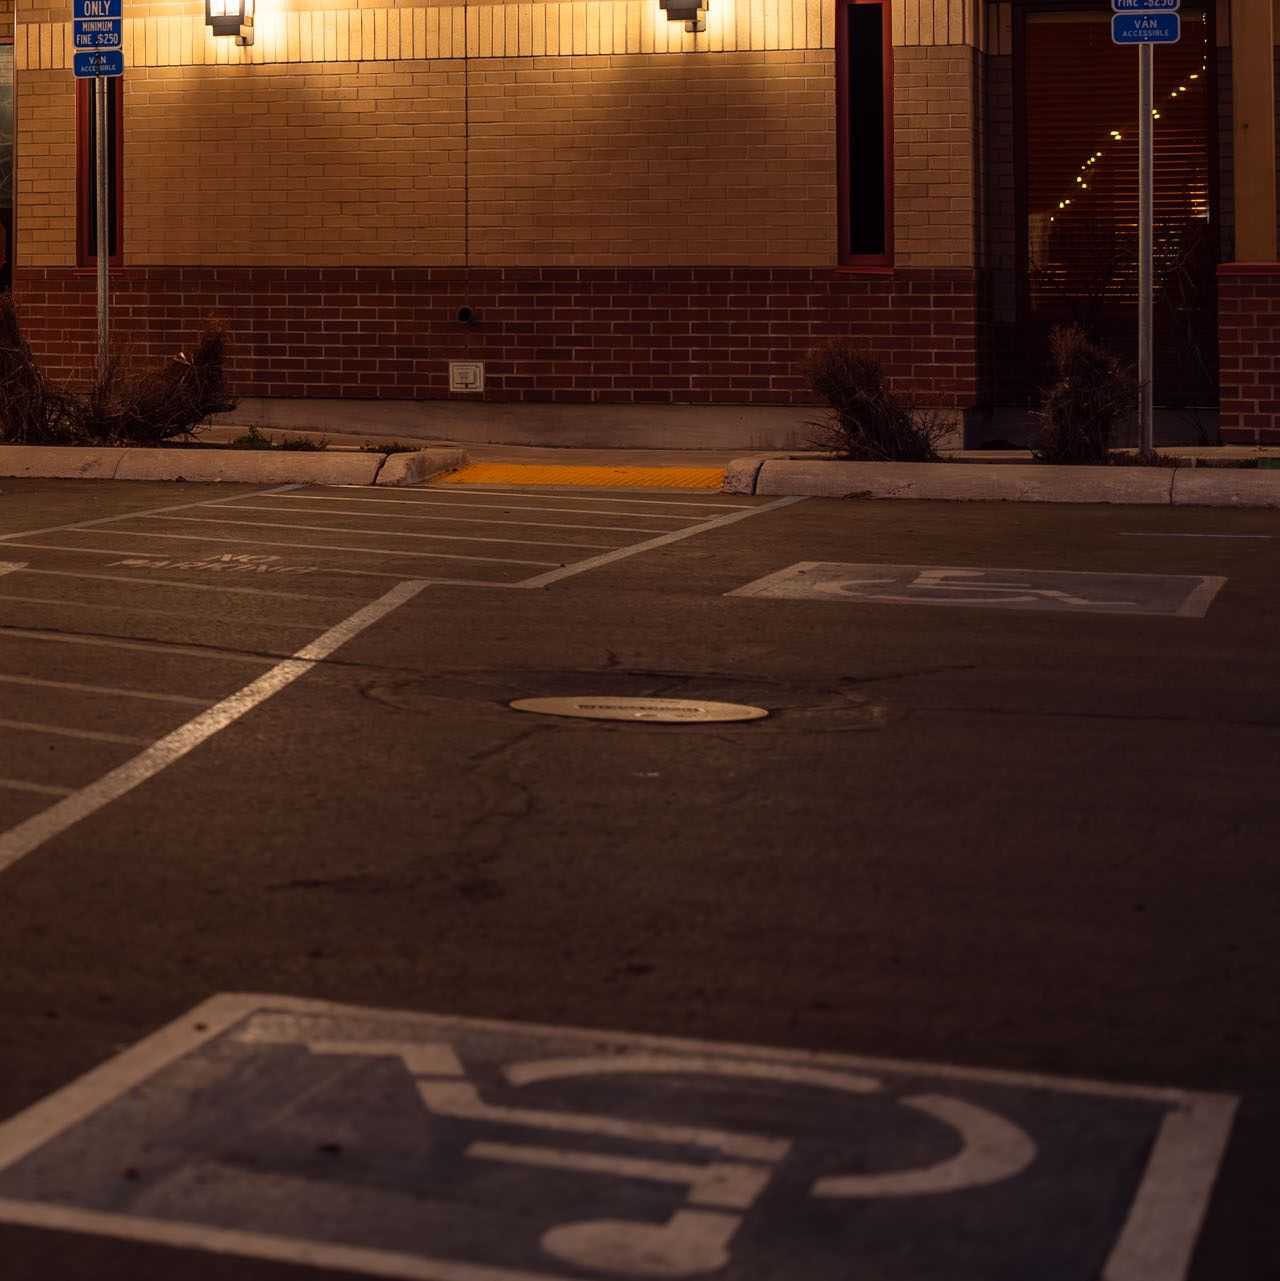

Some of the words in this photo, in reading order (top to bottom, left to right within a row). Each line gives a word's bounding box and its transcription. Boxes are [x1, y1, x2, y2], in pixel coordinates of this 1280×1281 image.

[83, 0, 111, 16] ONLY
[82, 21, 113, 32] MINIMUM
[1134, 20, 1157, 28] VAN
[76, 34, 92, 44] FINE
